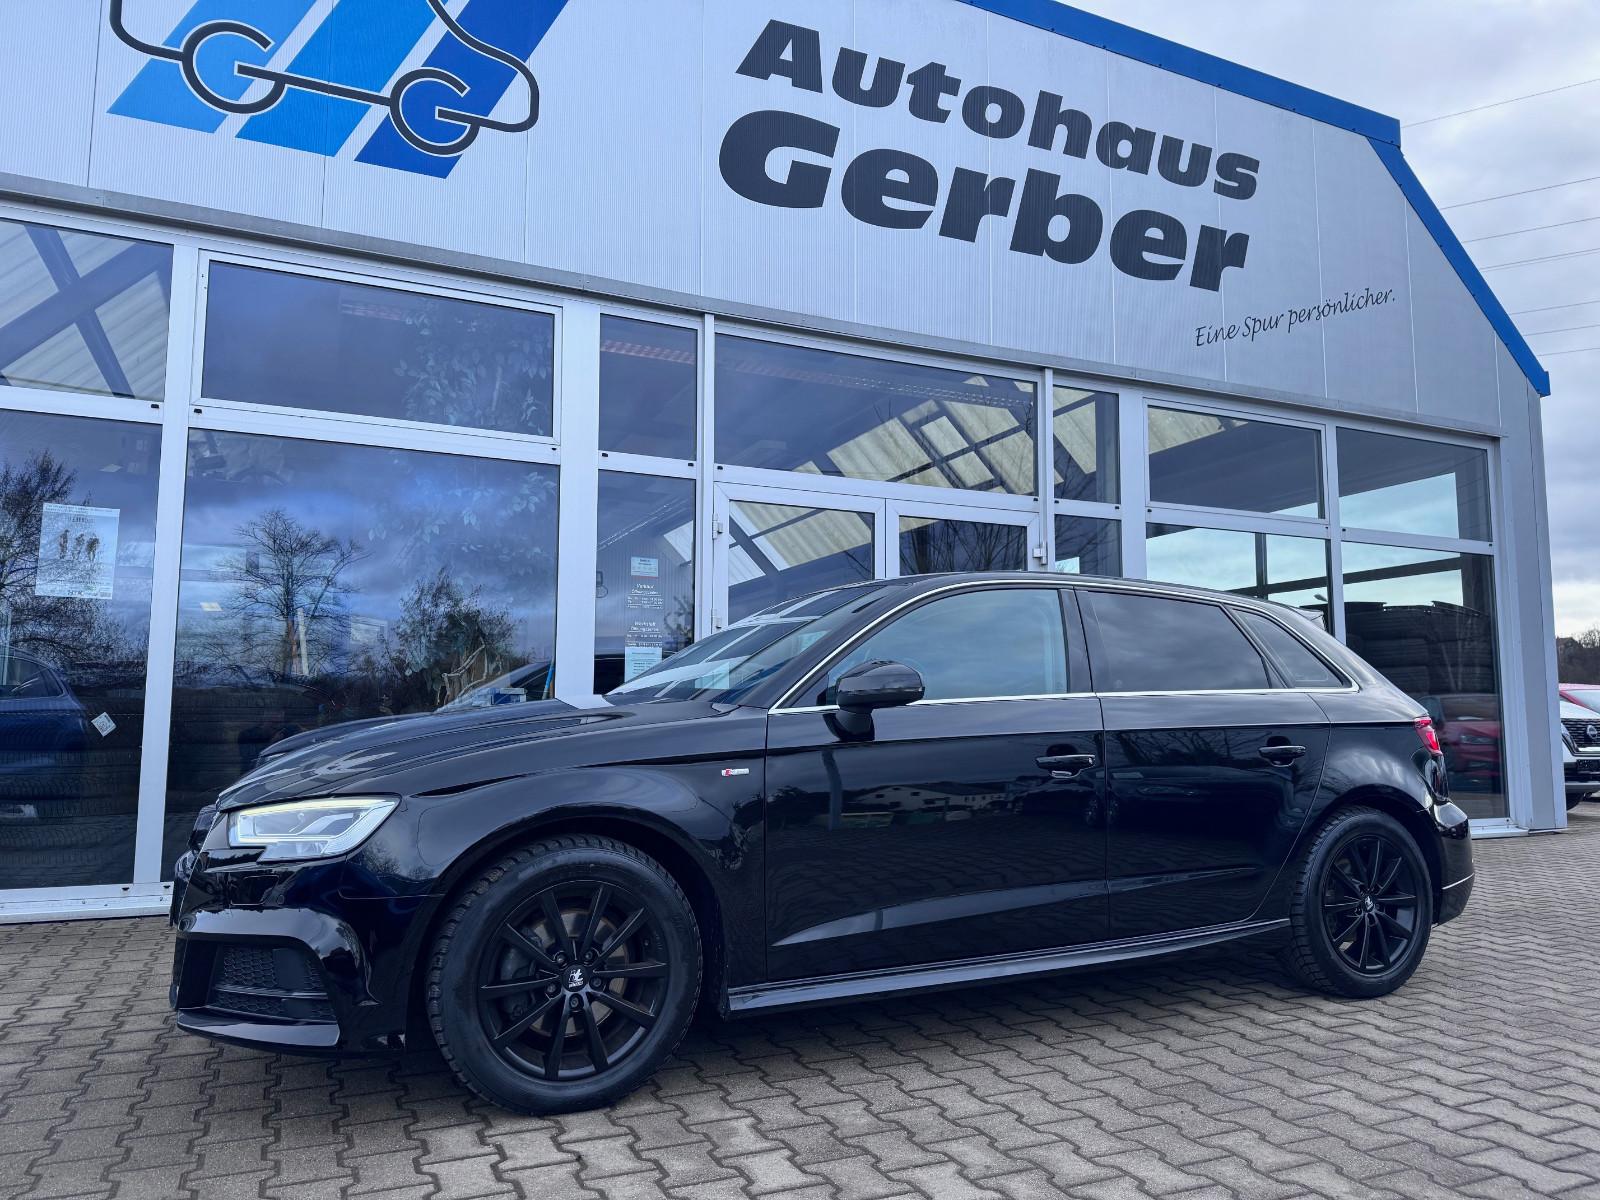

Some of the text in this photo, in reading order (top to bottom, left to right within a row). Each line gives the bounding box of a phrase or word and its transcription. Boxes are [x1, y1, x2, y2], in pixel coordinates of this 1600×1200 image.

[735, 18, 1260, 200] Autohaus
[718, 109, 1250, 292] Gerber
[1195, 287, 1396, 347] Eine Spur persönlicher.
